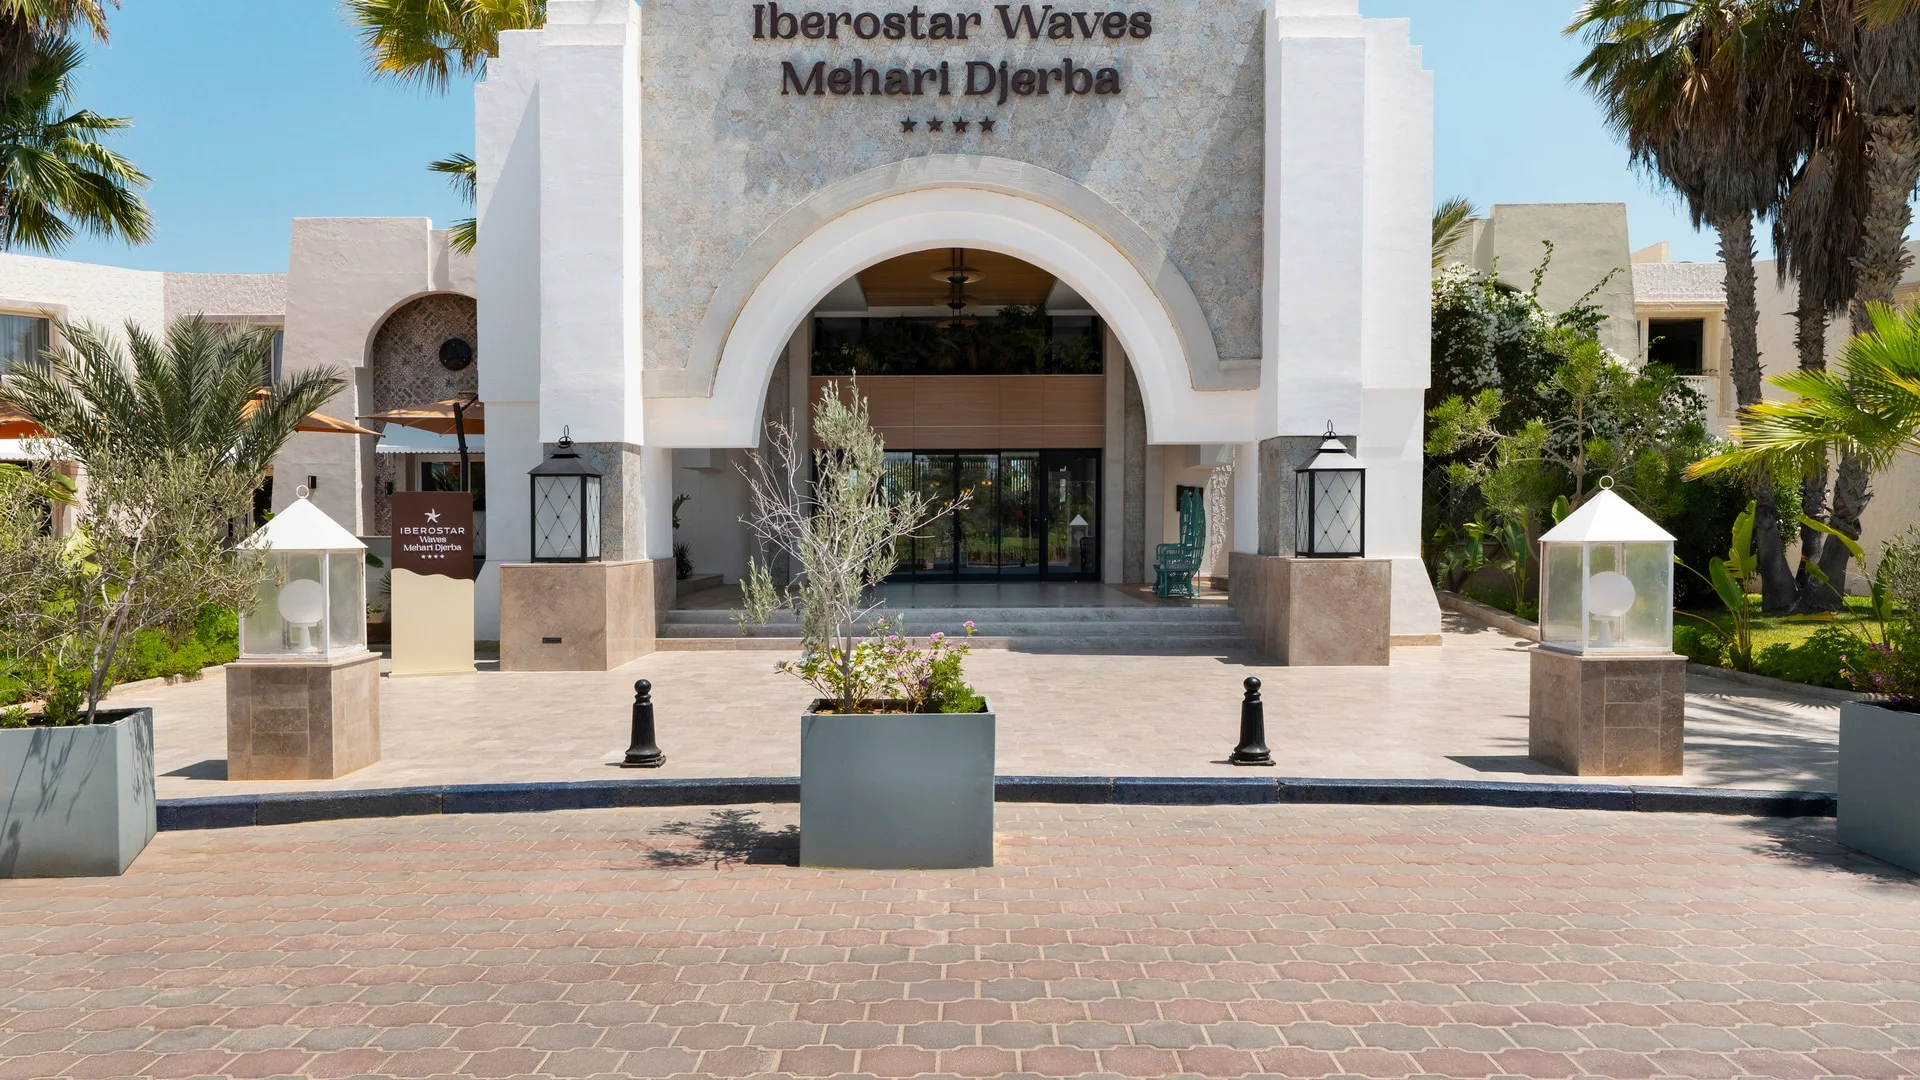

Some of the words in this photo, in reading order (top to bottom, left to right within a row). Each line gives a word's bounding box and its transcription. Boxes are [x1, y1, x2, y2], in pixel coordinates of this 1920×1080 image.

[752, 2, 982, 40] Iberostar
[993, 4, 1153, 40] Waves
[781, 58, 950, 96] Mehari
[965, 58, 1122, 105] Djerba
[400, 527, 465, 535] IBEROSTAR
[403, 543, 433, 551] Mehari
[435, 543, 462, 552] Djerba
